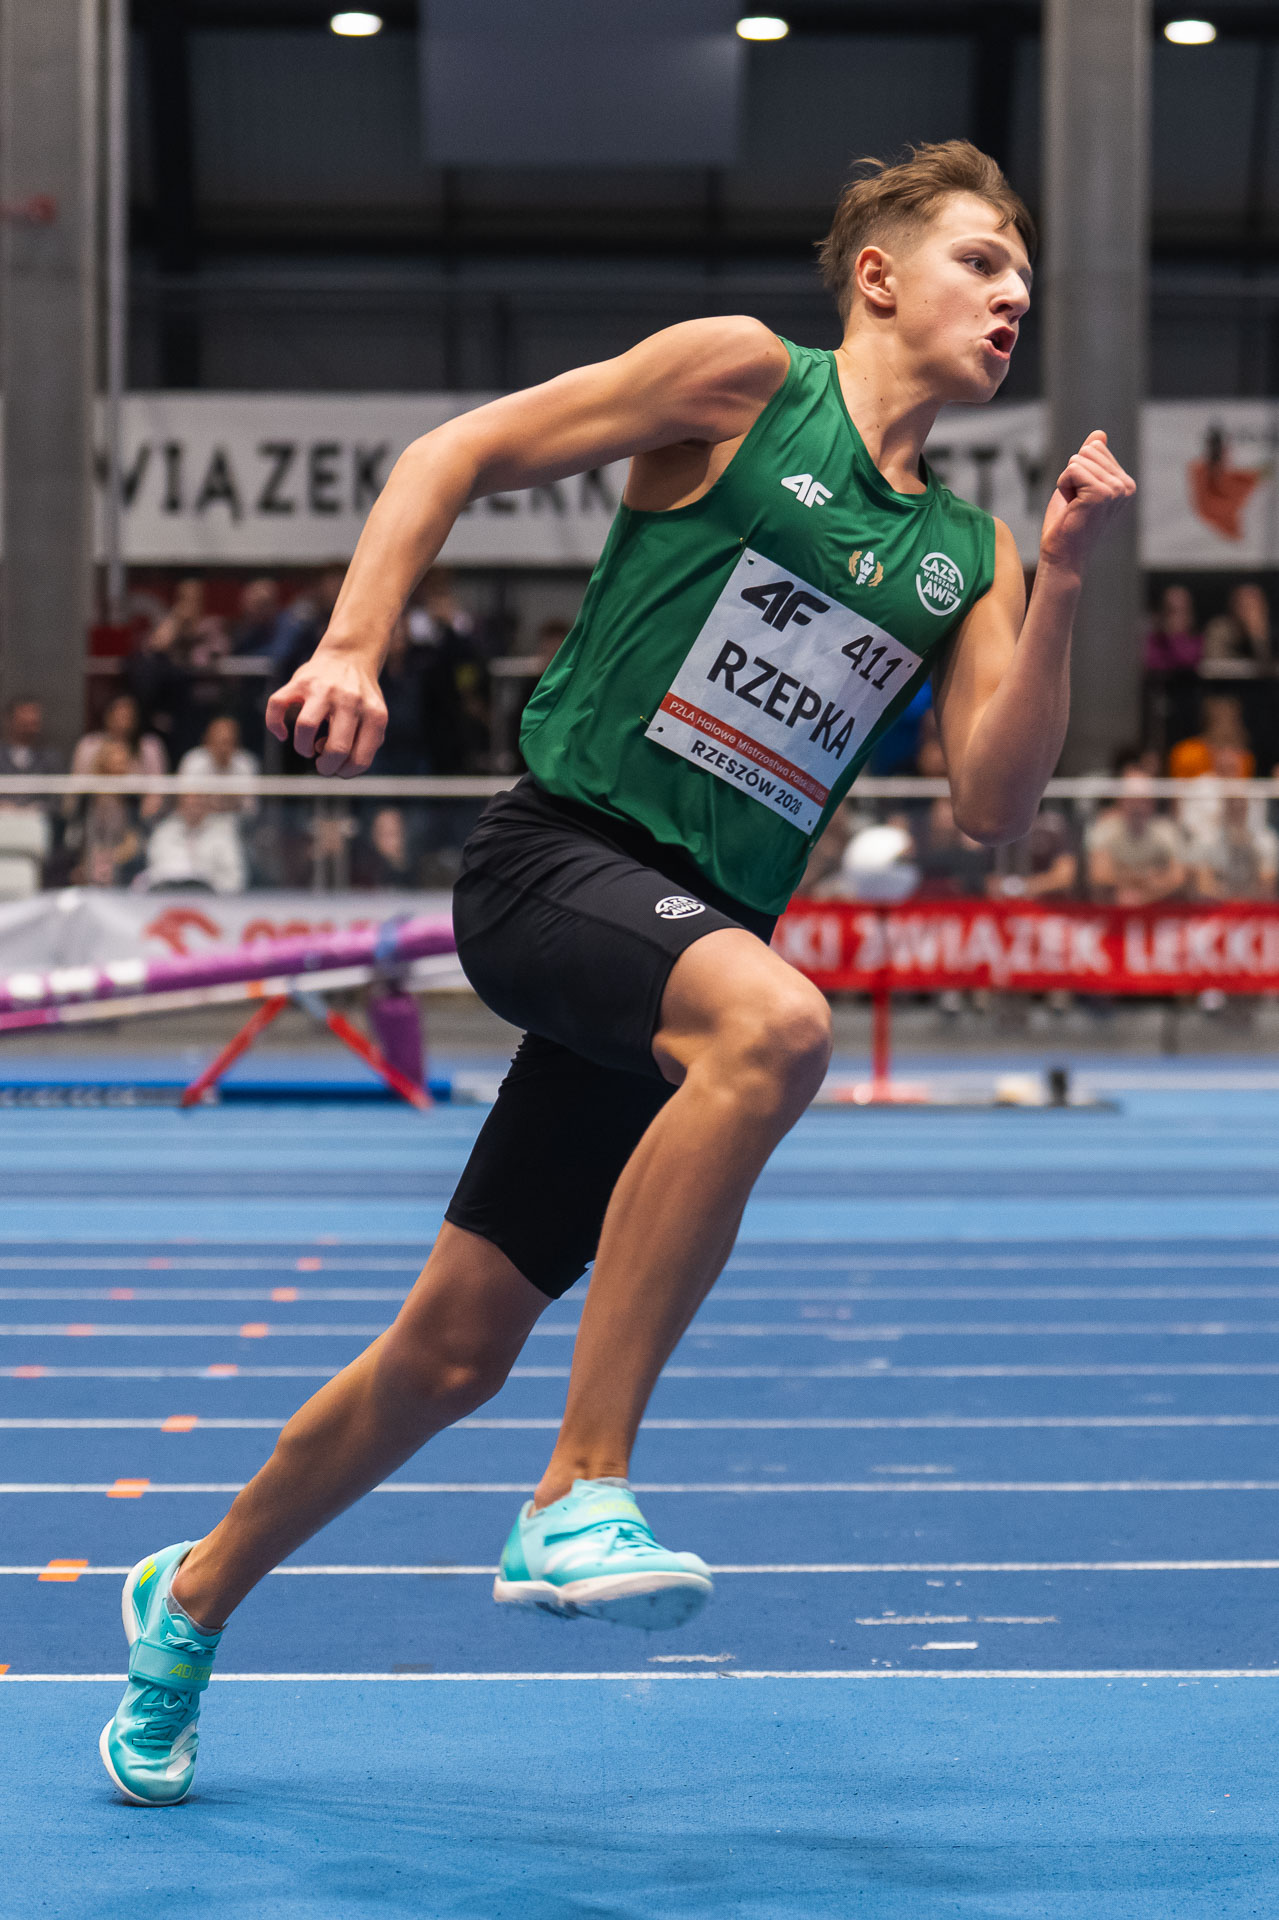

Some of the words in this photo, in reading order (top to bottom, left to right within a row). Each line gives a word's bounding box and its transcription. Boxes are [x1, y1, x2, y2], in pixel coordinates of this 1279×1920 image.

[780, 473, 834, 508] 4F
[922, 580, 956, 606] AWF
[923, 570, 958, 595] WARSZAWA
[927, 559, 957, 584] AZS
[740, 580, 831, 632] 4F
[841, 634, 904, 690] 411
[706, 639, 856, 760] RZEPKA
[669, 701, 695, 722] PZLA
[696, 716, 737, 744] Halowe
[737, 739, 789, 776] Mistrzostwa
[690, 739, 777, 797] RZESZÓW
[774, 789, 803, 816] 2026
